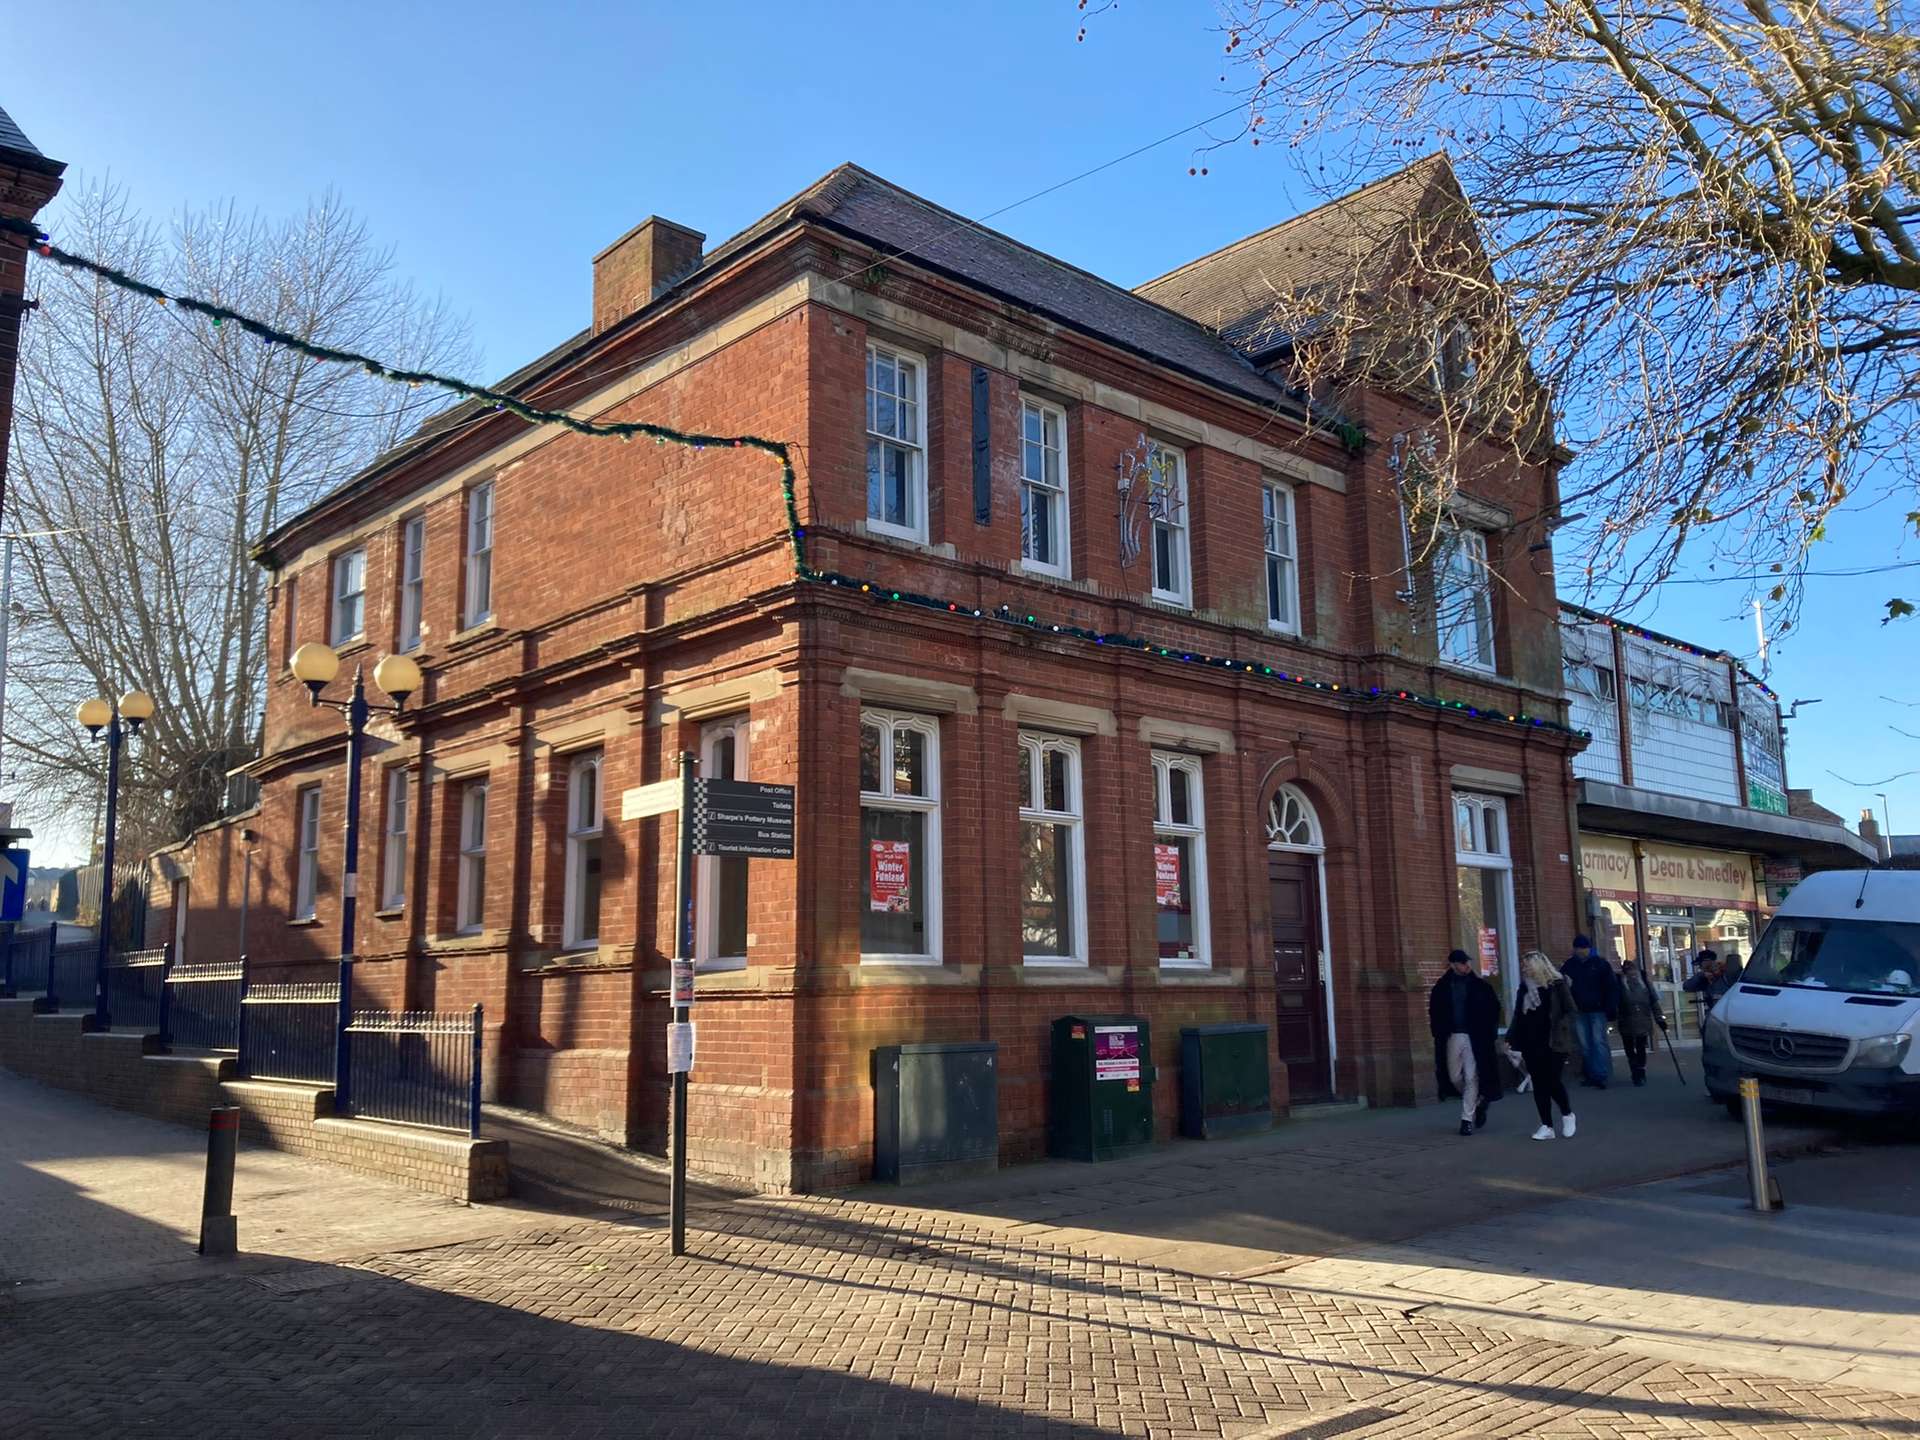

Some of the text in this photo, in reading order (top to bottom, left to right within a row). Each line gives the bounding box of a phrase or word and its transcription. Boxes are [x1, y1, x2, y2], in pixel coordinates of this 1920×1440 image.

[772, 802, 792, 810] Toilets
[717, 813, 792, 824] Sharpe's Pottery Museum
[771, 831, 792, 839] Station
[878, 860, 903, 872] Winter
[876, 871, 905, 882] Funland
[1650, 855, 1683, 878] Dean
[1686, 861, 1695, 879] &
[1697, 860, 1746, 890] Smedley
